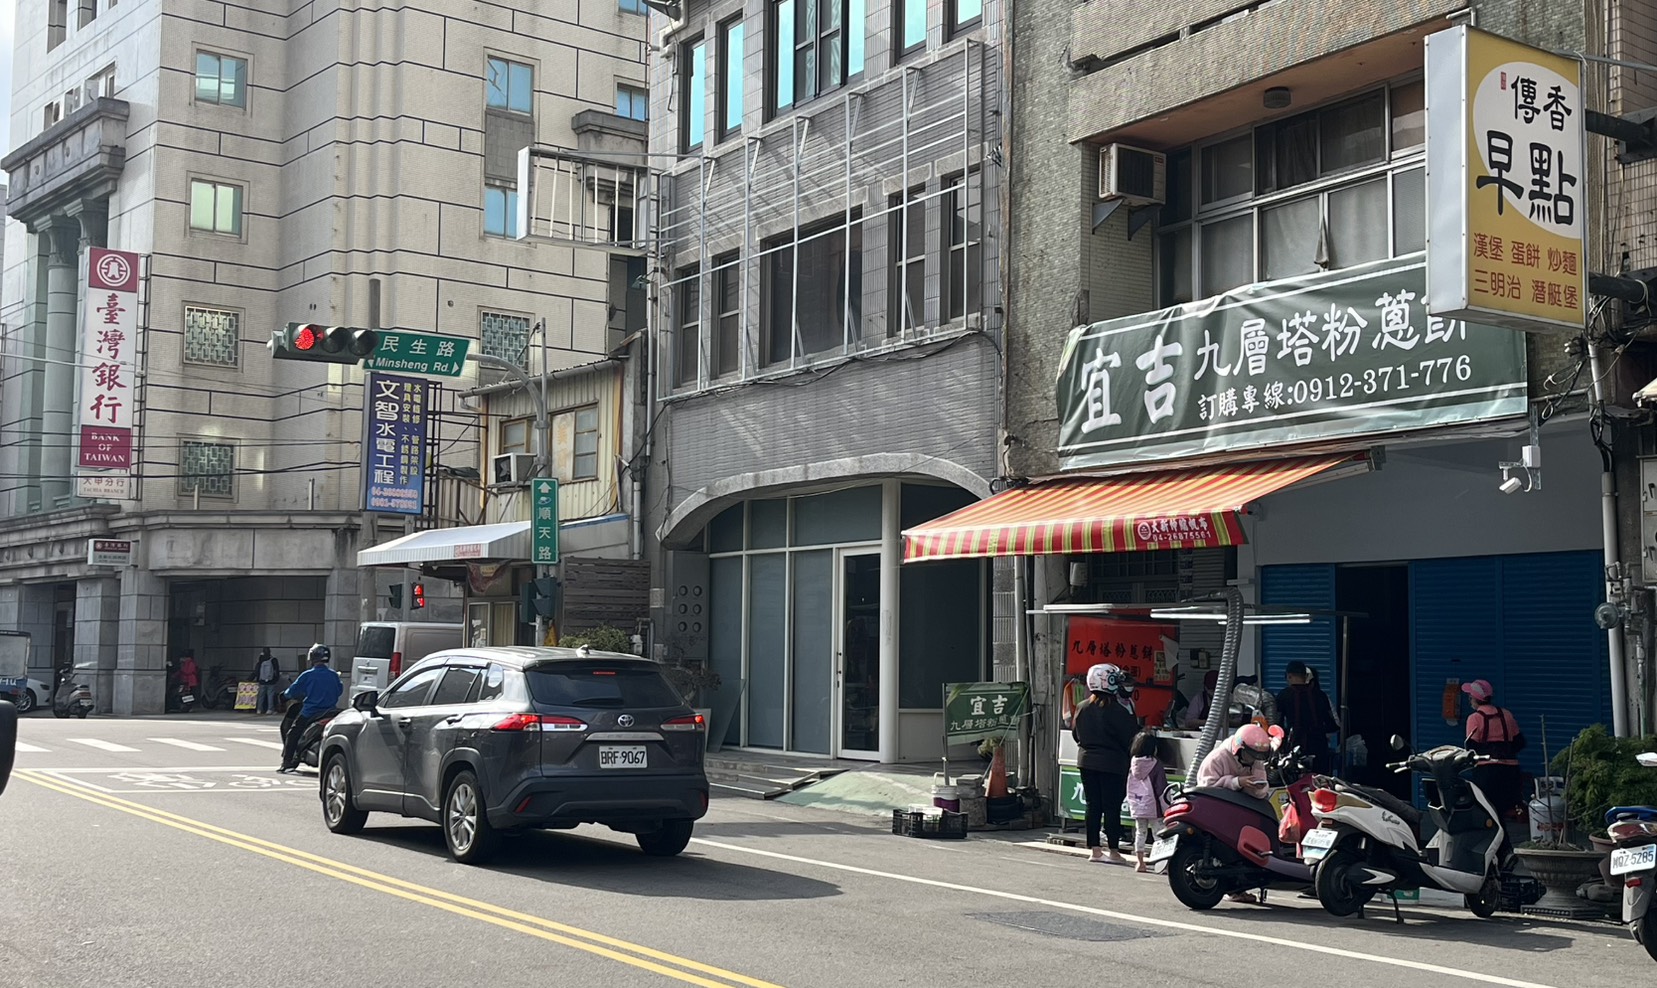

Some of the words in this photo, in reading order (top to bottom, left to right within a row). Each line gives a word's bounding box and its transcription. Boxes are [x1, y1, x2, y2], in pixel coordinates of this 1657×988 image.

[1510, 75, 1573, 132] 傳香
[1476, 129, 1578, 226] 早點
[1473, 232, 1504, 262] 漢堡
[1511, 240, 1541, 269] 蛋餅
[1473, 268, 1522, 300] 三明治
[1531, 279, 1579, 310] 潛艇堡
[90, 292, 127, 424] 臺灣銀行
[375, 357, 428, 373] Minsheng
[380, 335, 456, 358] 民生路
[1081, 329, 1183, 435] 宜吉
[91, 432, 120, 441] BANK
[98, 443, 113, 451] OF
[374, 380, 400, 485] 文智水電工程
[84, 452, 125, 462] TAIWAN
[538, 507, 552, 561] 順天路
[970, 694, 1008, 716] 宜吉
[600, 750, 646, 765] BRF-9067
